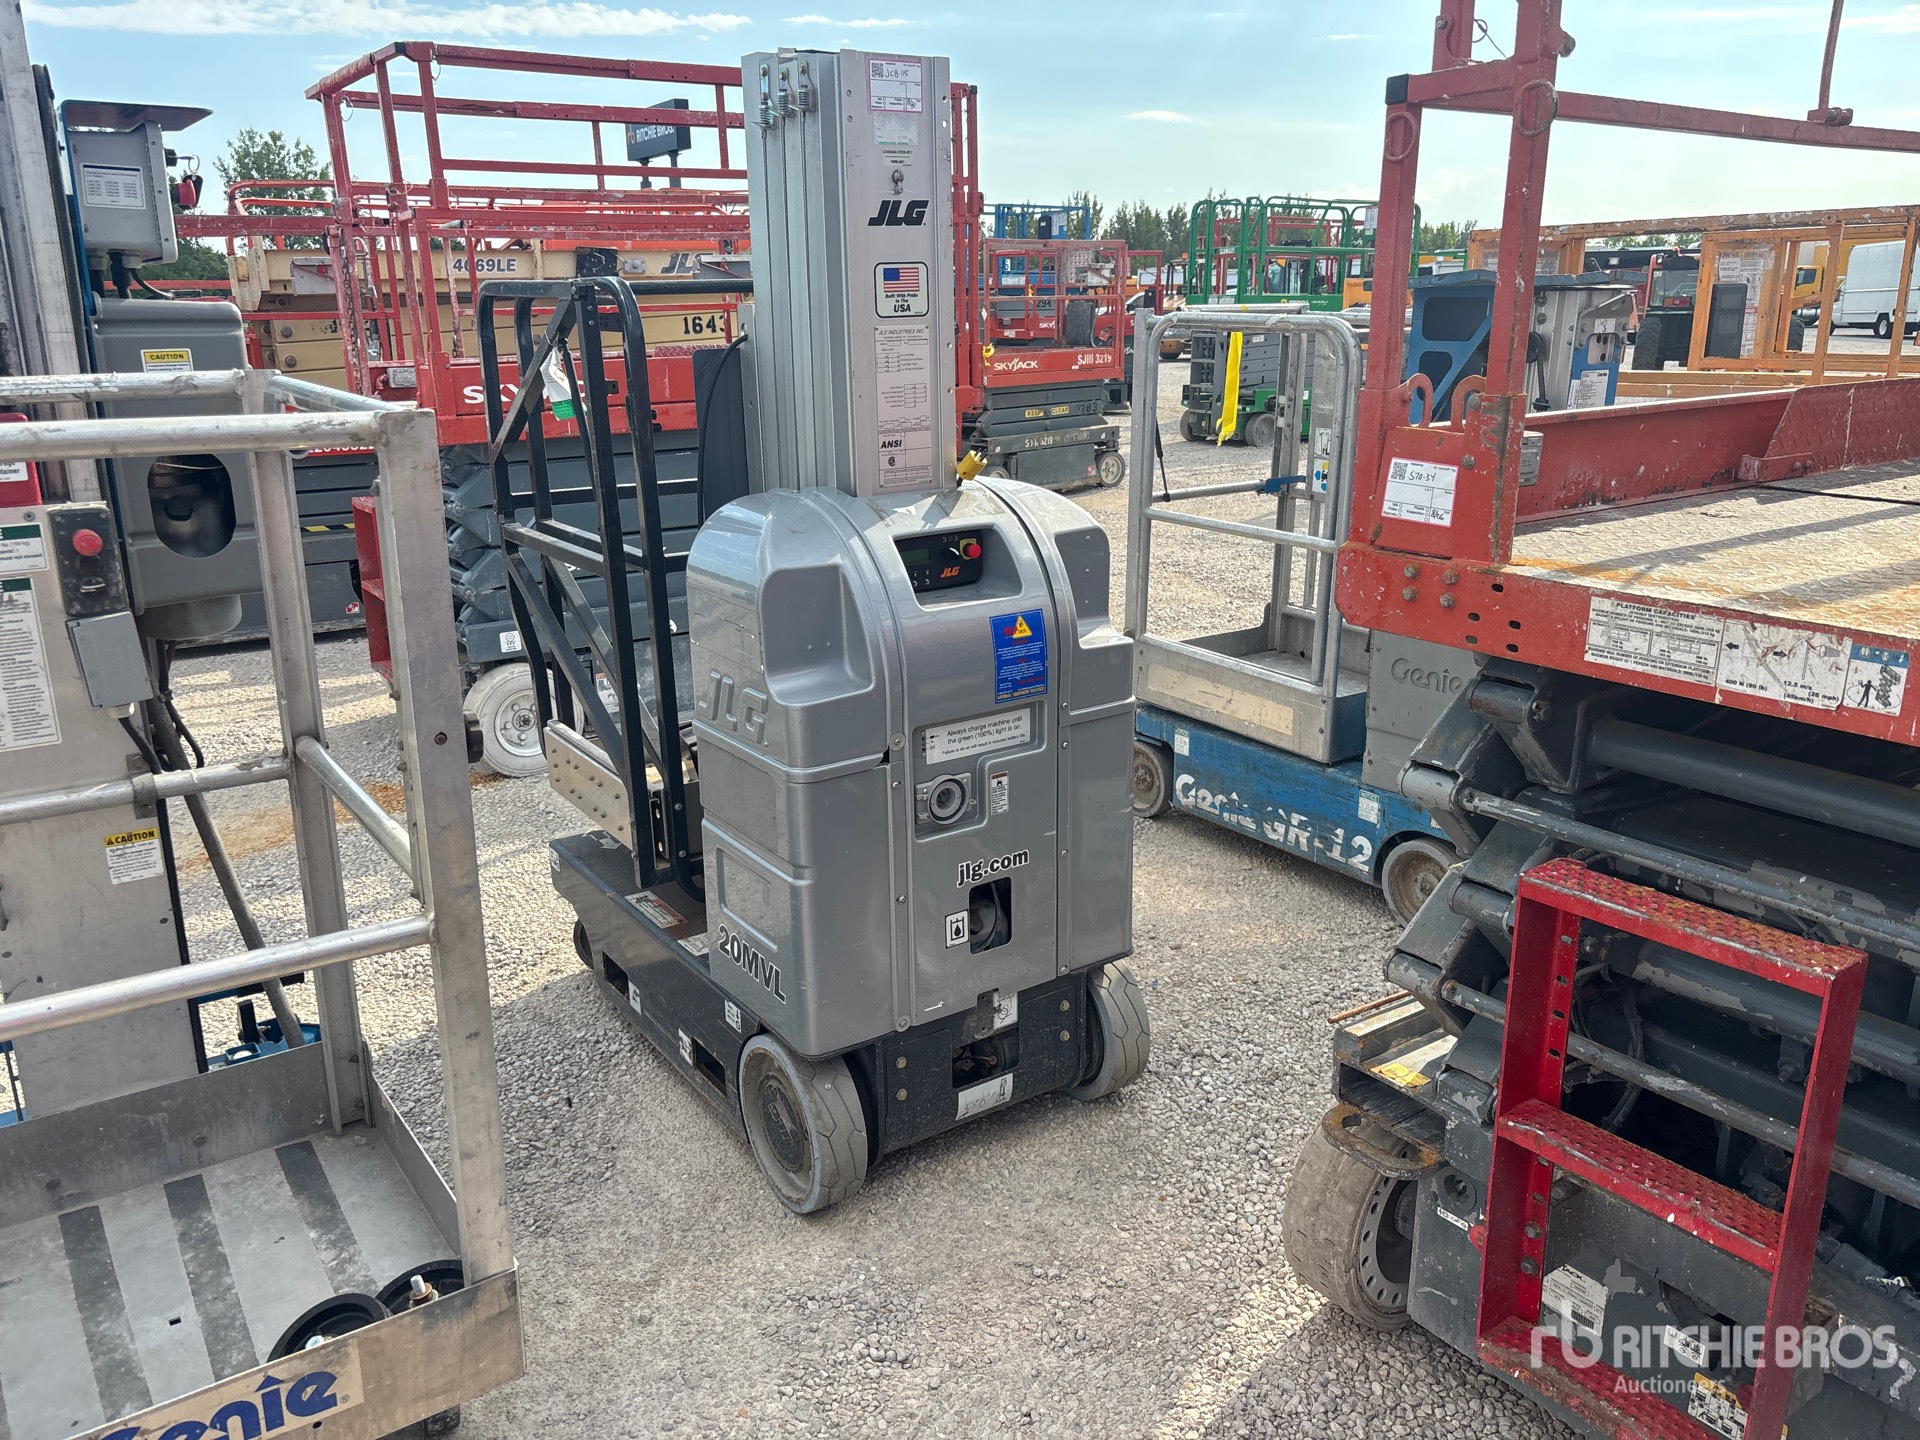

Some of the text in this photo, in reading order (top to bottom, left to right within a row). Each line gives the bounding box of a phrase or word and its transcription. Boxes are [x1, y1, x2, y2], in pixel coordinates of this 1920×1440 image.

[868, 200, 929, 226] JLG
[894, 304, 911, 313] USA
[994, 358, 1038, 372] SKYJACK
[1095, 354, 1112, 364] 3219
[880, 440, 902, 449] ANSI
[940, 566, 960, 578] JLG
[1616, 602, 1652, 612] PLATFORM
[1391, 658, 1464, 696] Genie
[1758, 684, 1768, 692] lb)
[698, 668, 768, 744] JLG
[1822, 694, 1839, 702] mph)
[947, 715, 1022, 737] Always charge machine until
[958, 734, 974, 743] green
[975, 730, 994, 740] (100%)
[995, 726, 1006, 734] light
[115, 830, 155, 844] CAUTION
[957, 849, 1030, 888] jlg.com
[718, 924, 786, 1004] 20MVL
